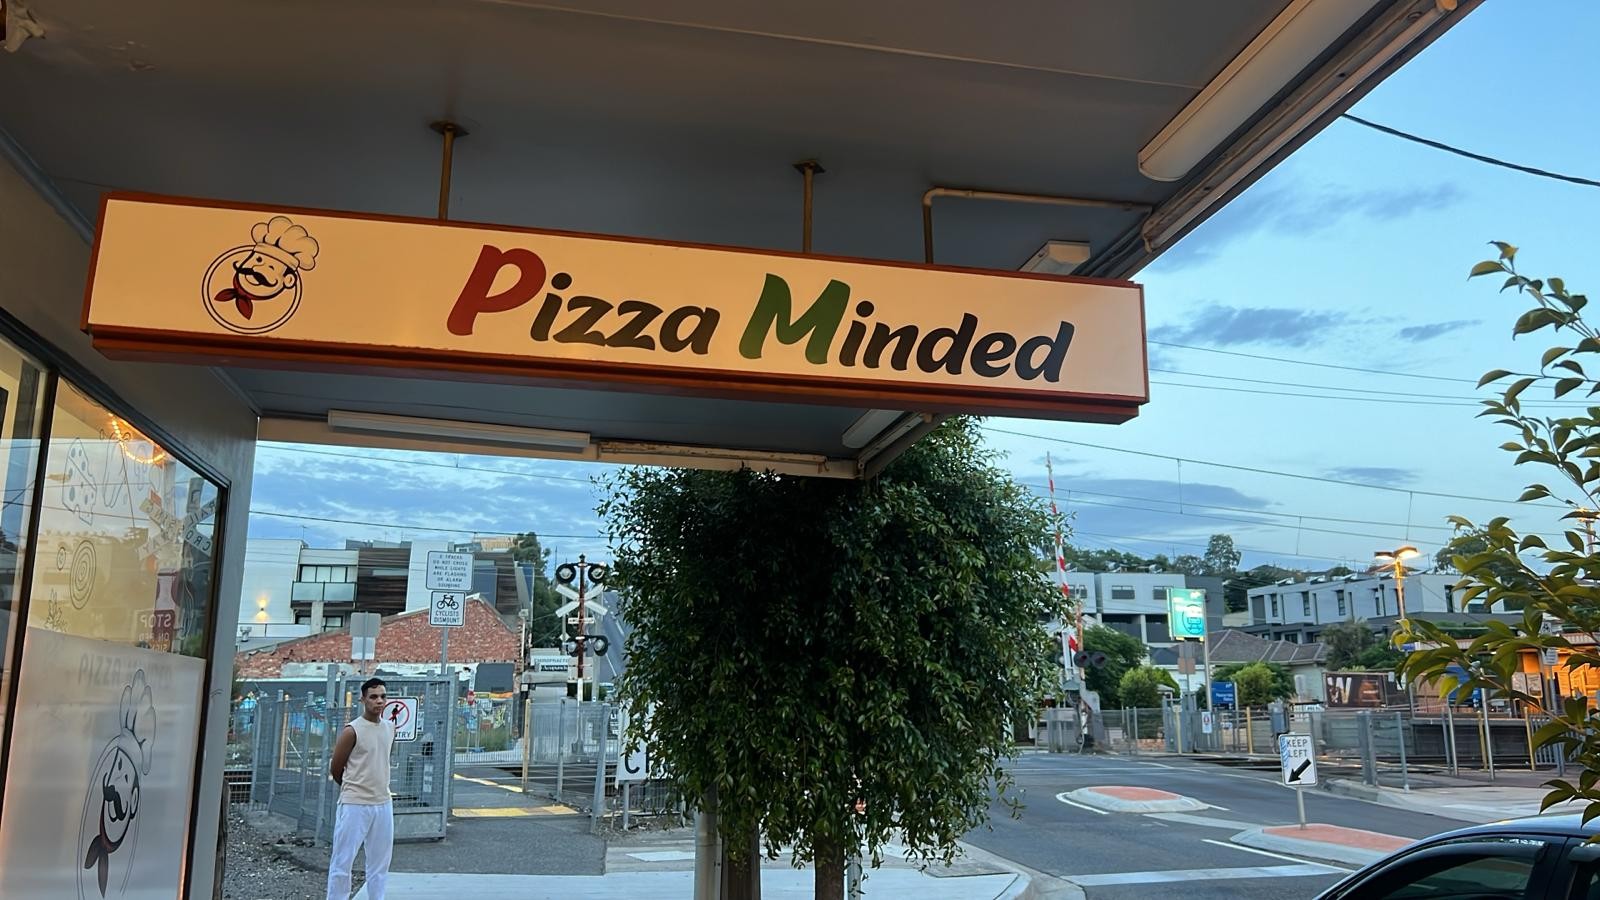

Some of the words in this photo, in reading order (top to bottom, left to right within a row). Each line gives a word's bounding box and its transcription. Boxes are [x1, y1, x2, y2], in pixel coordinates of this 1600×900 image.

[446, 243, 721, 355] Pizza
[738, 273, 1075, 383] Minded
[1287, 738, 1308, 748] KEEP
[1288, 749, 1308, 758] LEFT
